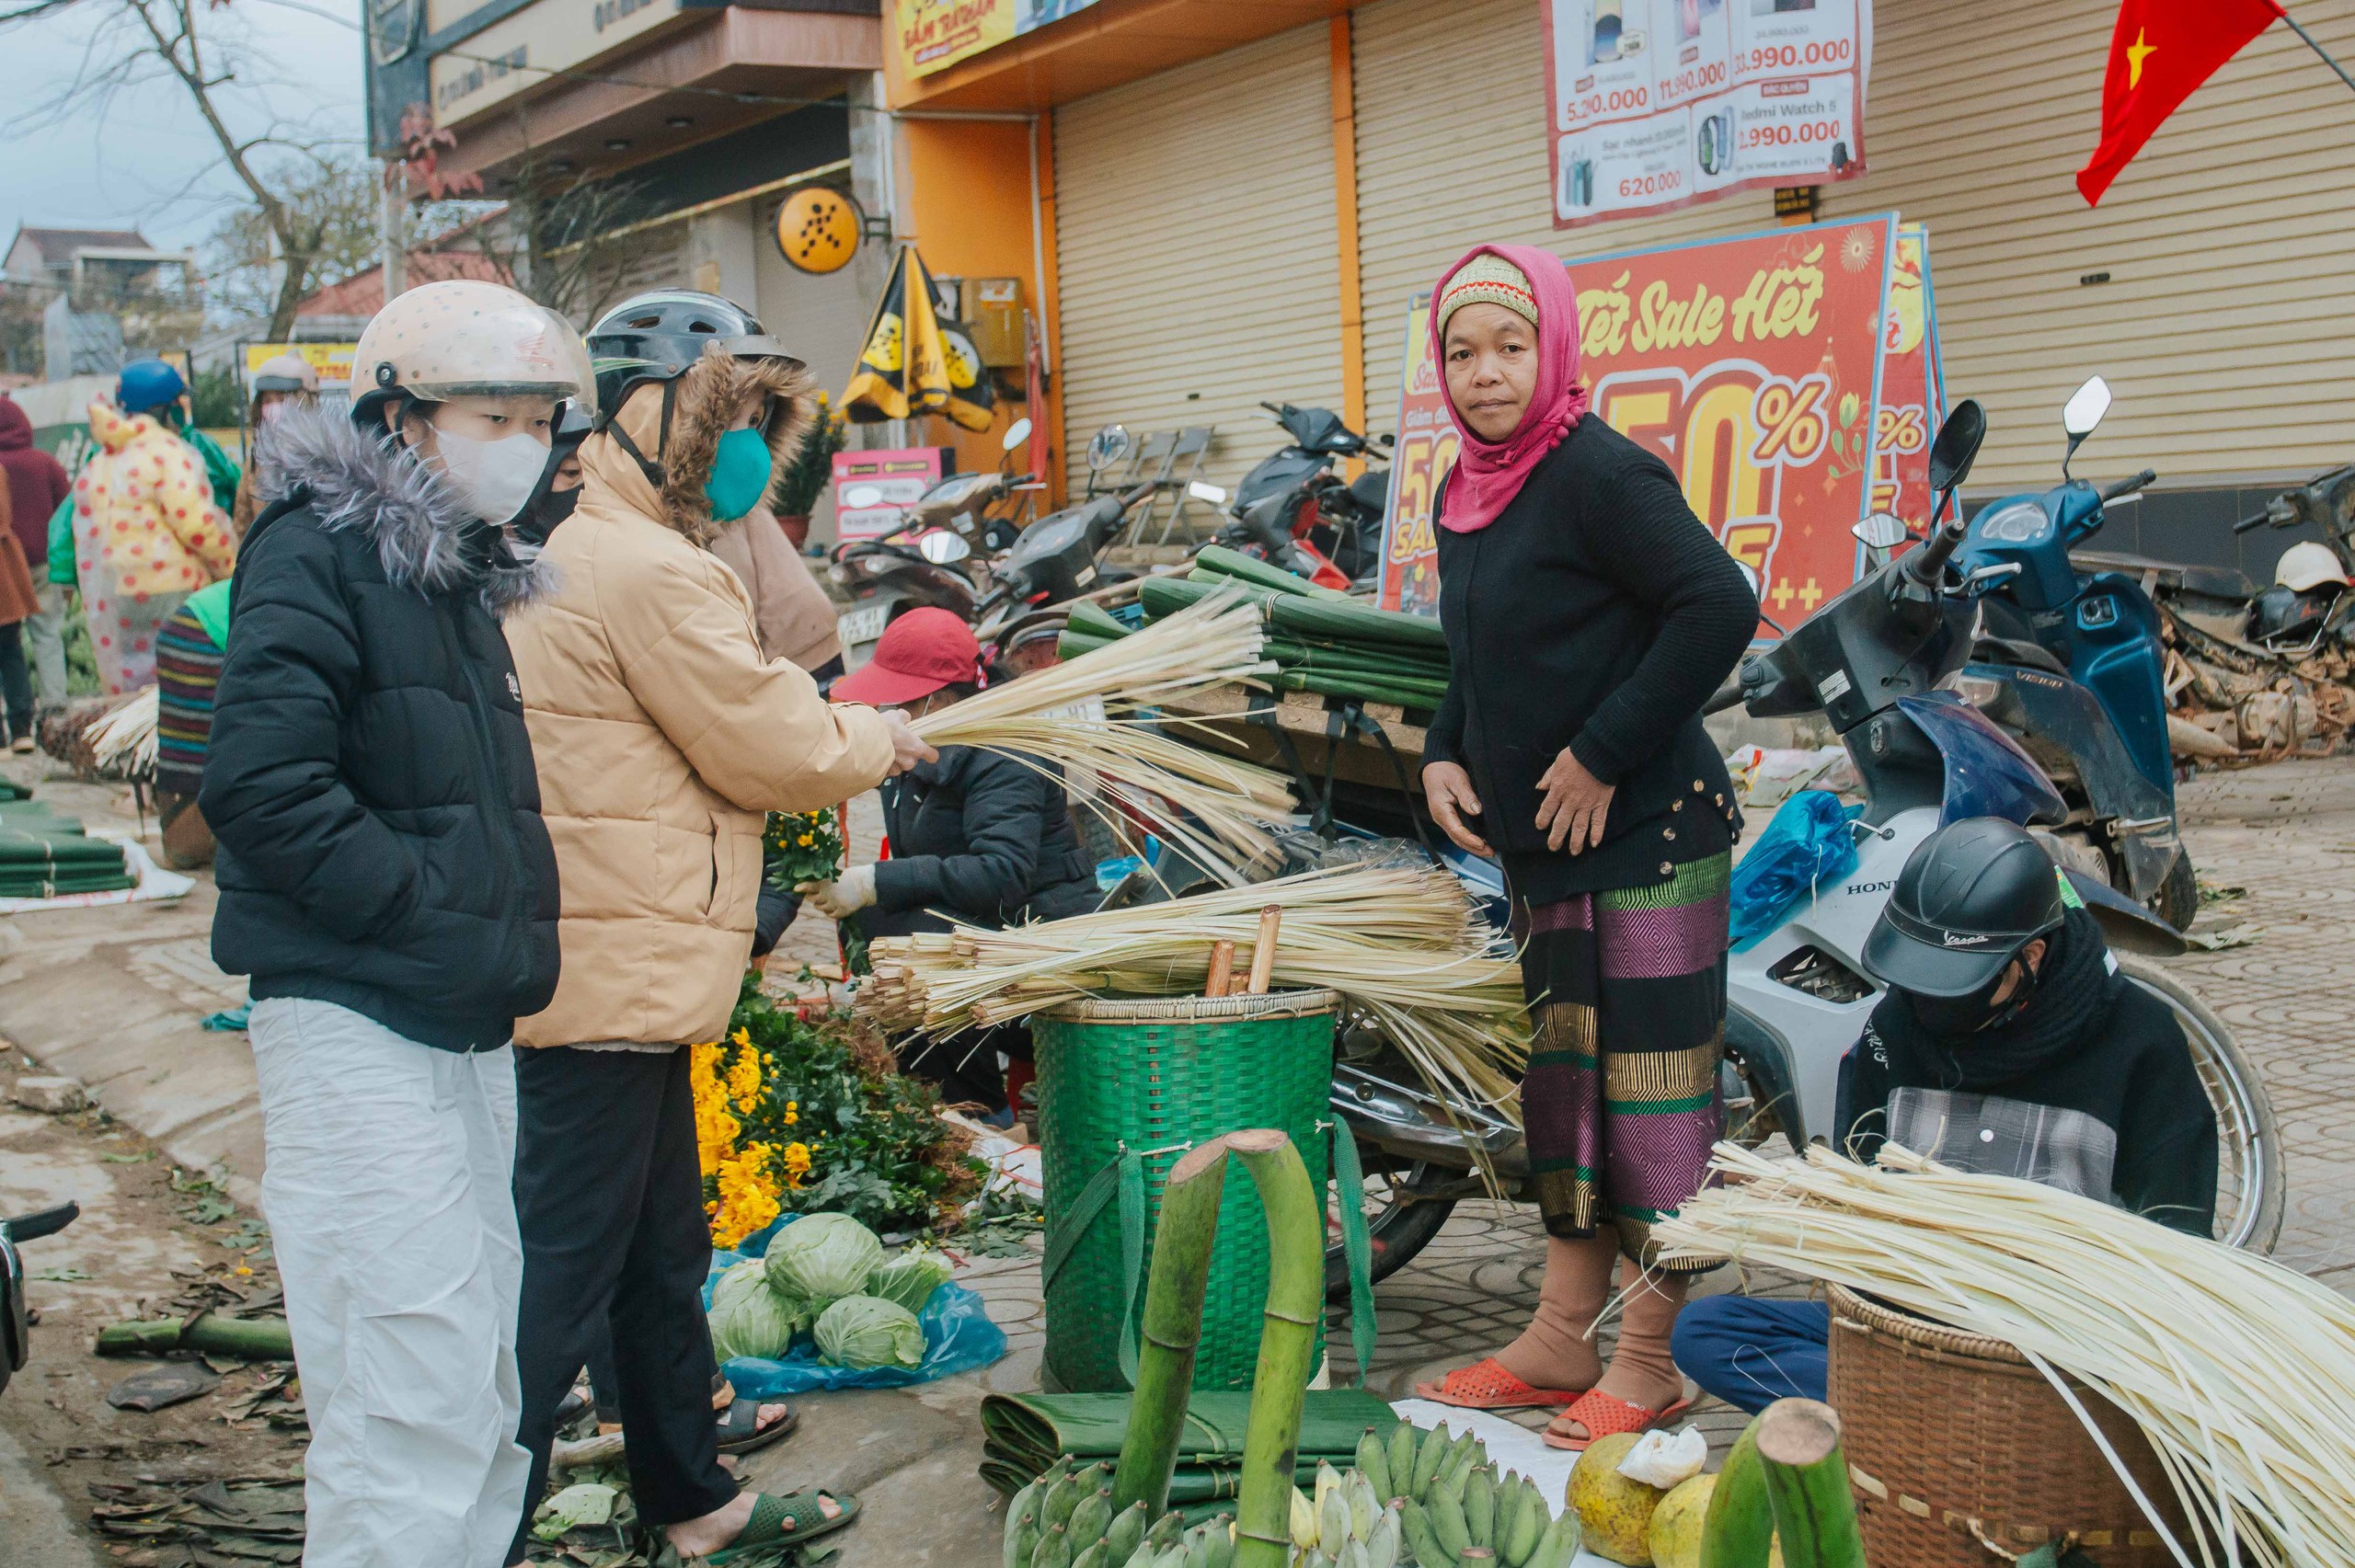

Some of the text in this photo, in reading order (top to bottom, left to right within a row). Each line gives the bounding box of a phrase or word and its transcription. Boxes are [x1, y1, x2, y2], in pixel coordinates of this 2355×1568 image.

[1780, 100, 1824, 117] Watch
[1576, 269, 1630, 358] Tết
[1631, 280, 1726, 354] Sale
[1731, 242, 1824, 343] Hết
[2016, 670, 2063, 689] VISION
[1944, 930, 1989, 945] Vespa
